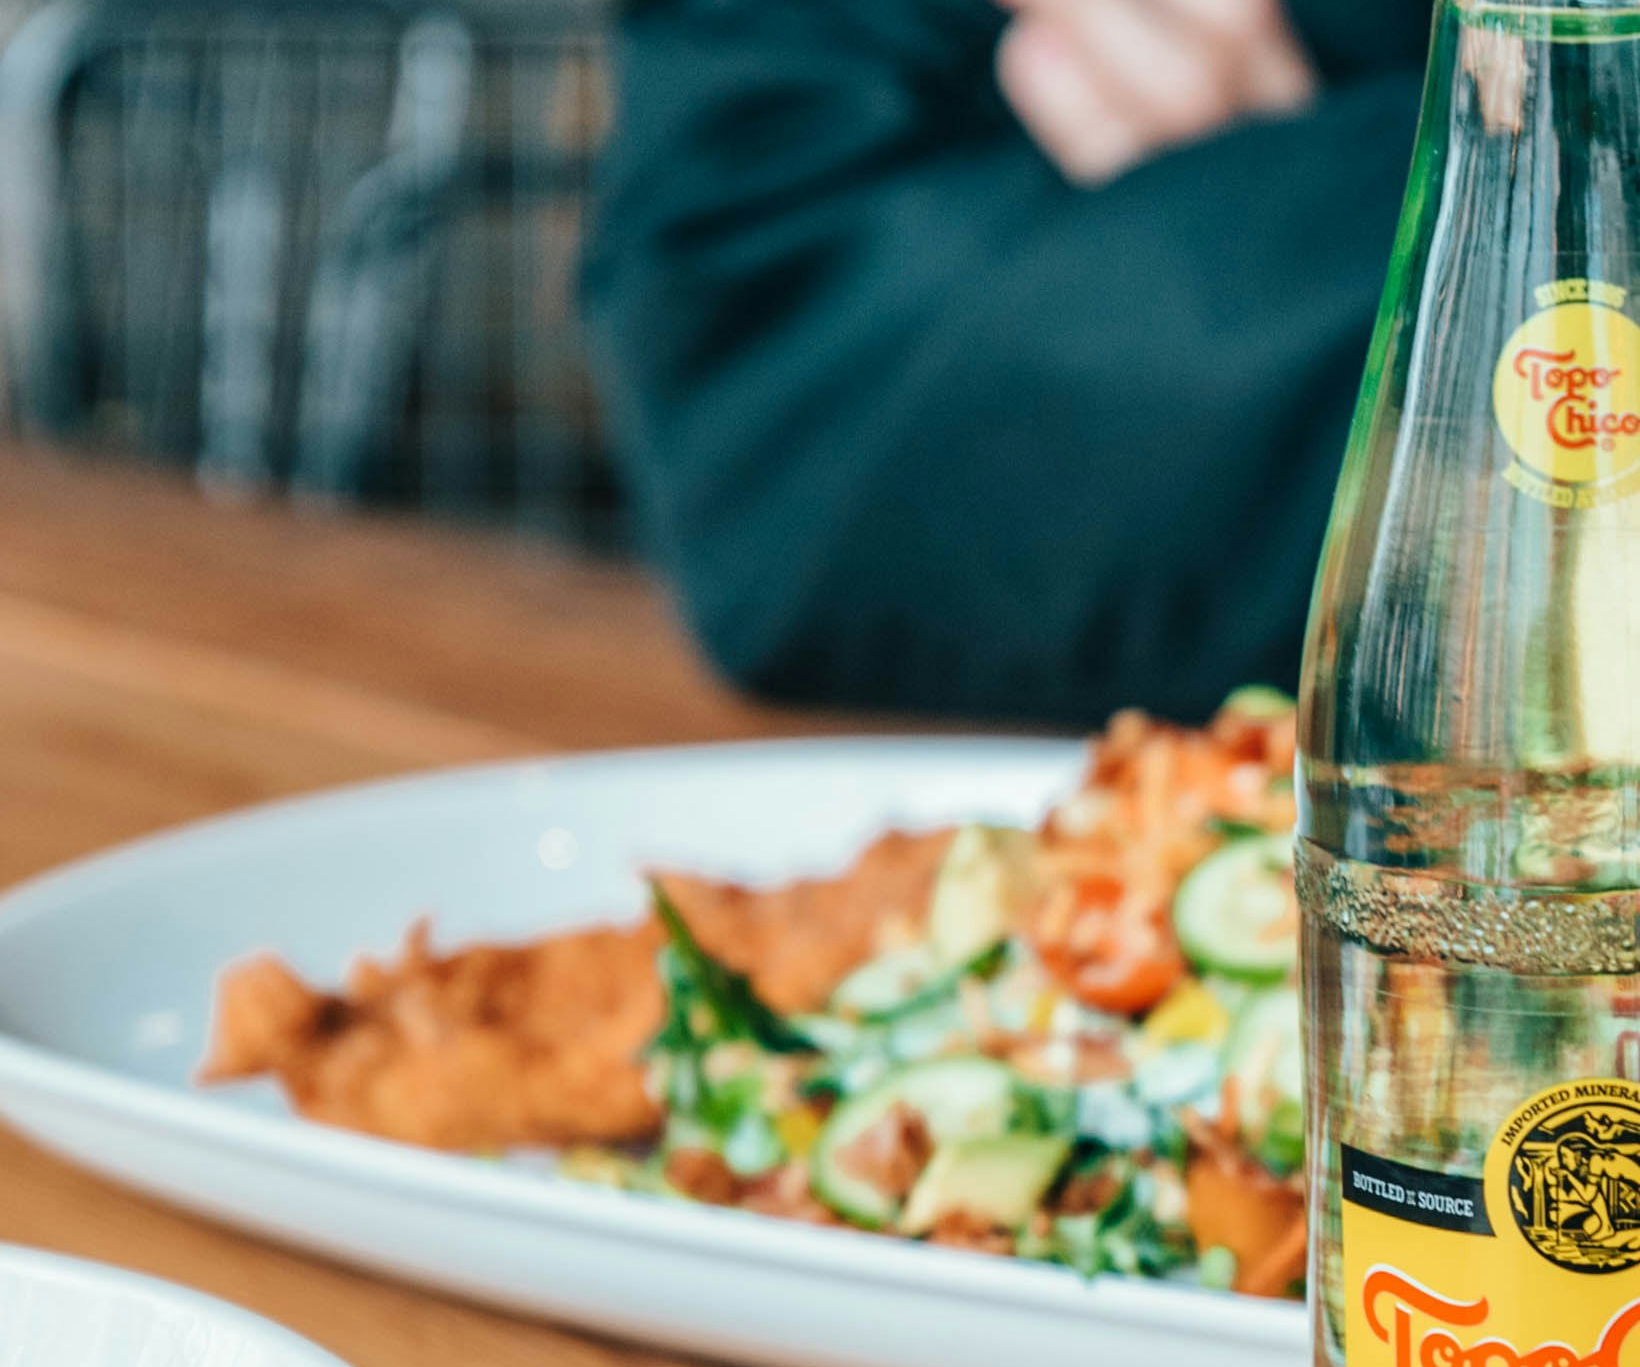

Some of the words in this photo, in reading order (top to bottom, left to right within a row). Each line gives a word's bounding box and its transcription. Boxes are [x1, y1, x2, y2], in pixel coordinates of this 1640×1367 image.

[1513, 349, 1622, 402] Topo
[1500, 1089, 1571, 1147] IMPORTED
[1352, 1170, 1405, 1204] BOTTLED
[1417, 1190, 1475, 1218] SOURCE
